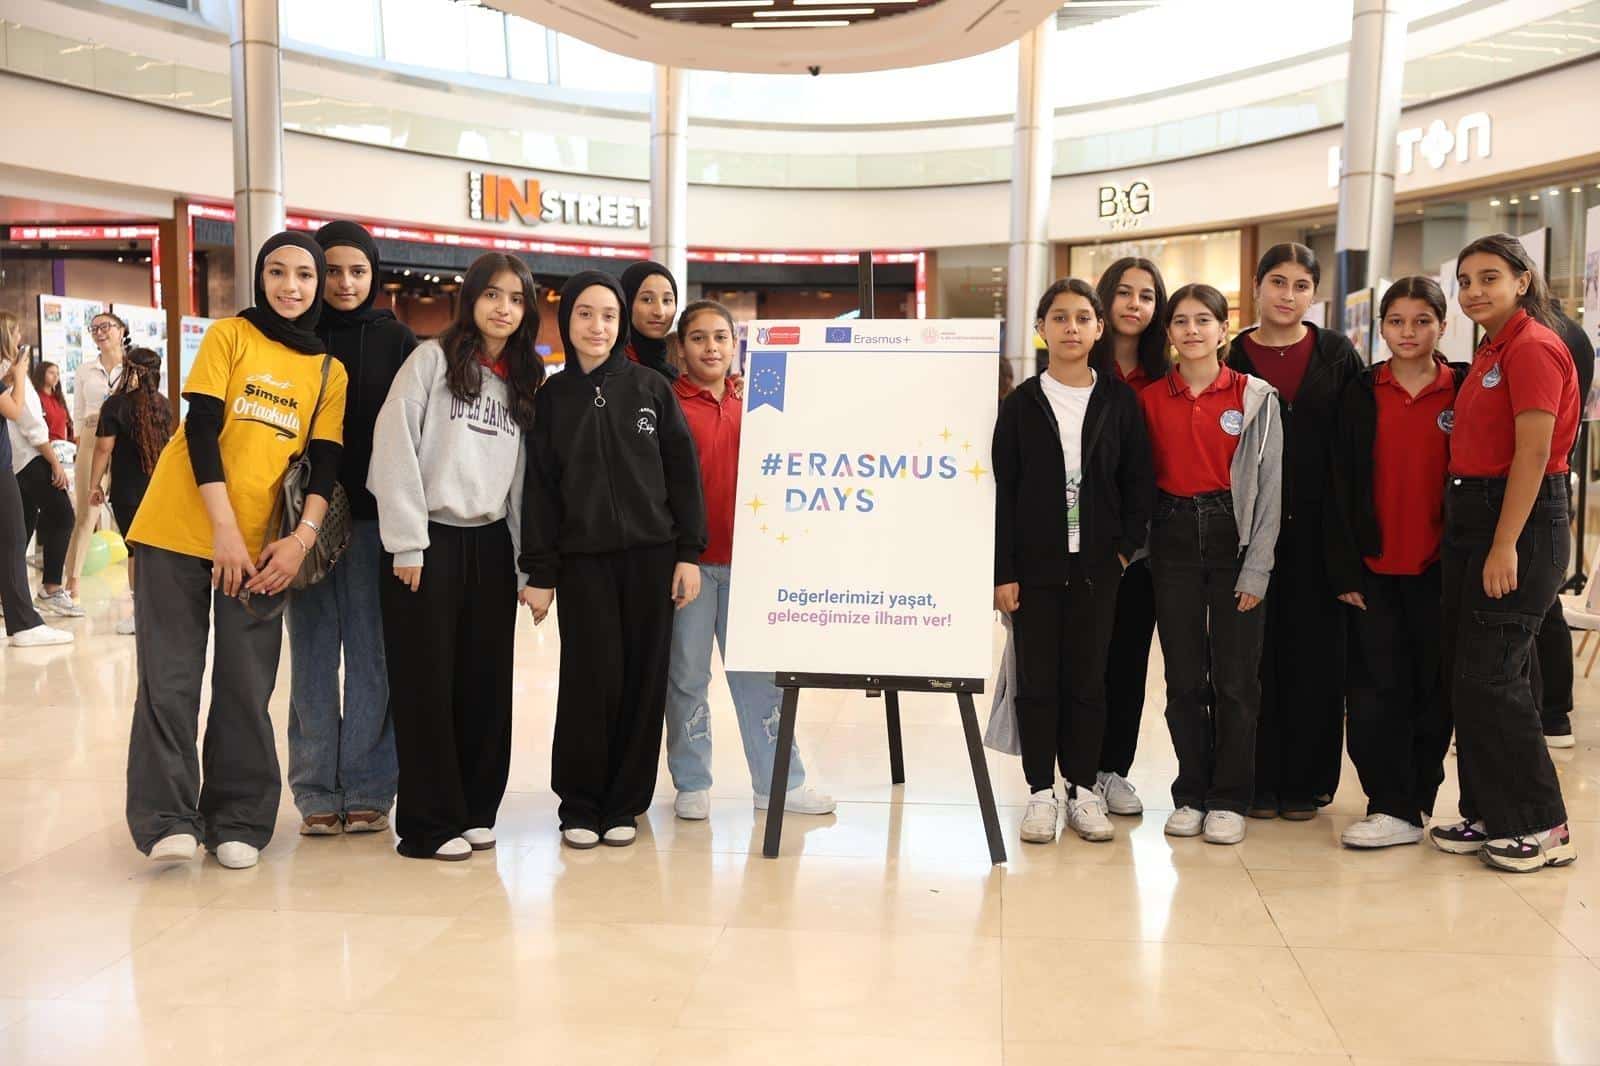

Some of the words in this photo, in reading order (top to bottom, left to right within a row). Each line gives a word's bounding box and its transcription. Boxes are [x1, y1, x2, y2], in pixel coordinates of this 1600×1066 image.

[853, 334, 911, 345] Erasmus+
[244, 383, 298, 409] Şimşek
[449, 394, 481, 420] OUER
[482, 396, 516, 437] BANKS
[761, 452, 957, 480] #ERASMUS
[785, 487, 875, 513] DAYS
[777, 588, 884, 606] Değerlerimizi
[889, 591, 937, 609] yaşat,
[767, 608, 870, 626] geleceğimize
[875, 610, 918, 626] ilham
[922, 612, 952, 627] ver!
